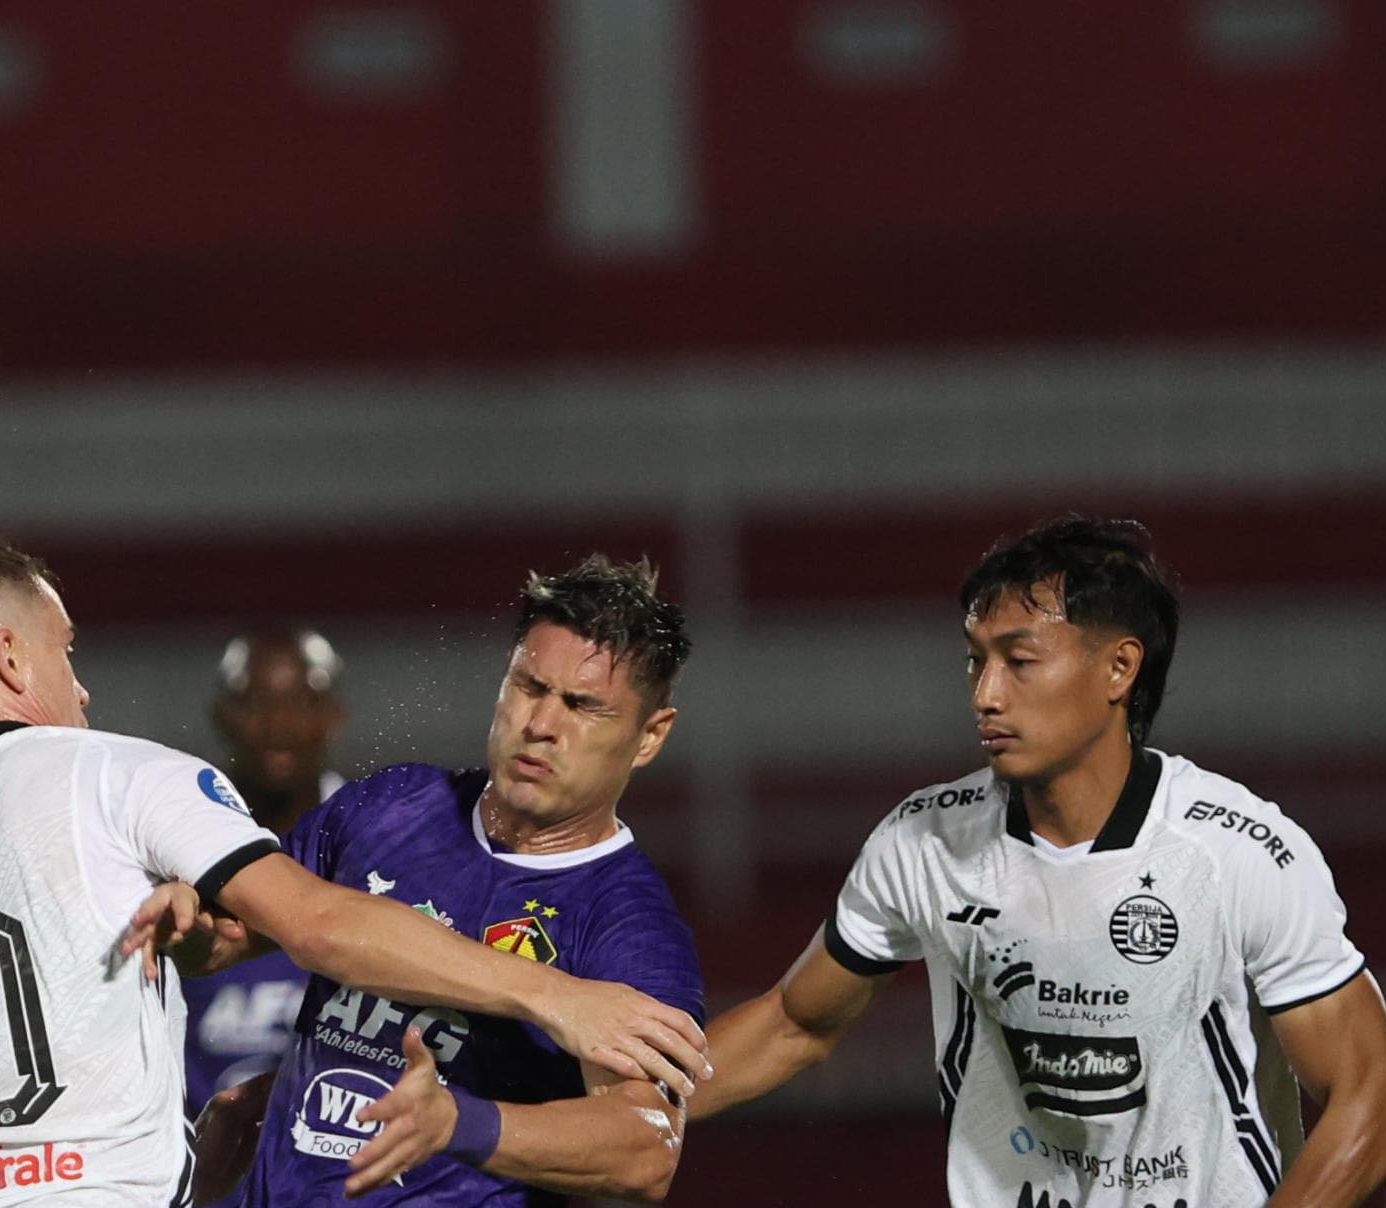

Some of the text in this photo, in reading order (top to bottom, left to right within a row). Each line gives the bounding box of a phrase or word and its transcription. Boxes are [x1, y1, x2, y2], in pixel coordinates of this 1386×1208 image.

[1037, 979, 1130, 1006] Bakrie
[315, 982, 471, 1064] AFG
[1124, 1145, 1187, 1177] BANK
